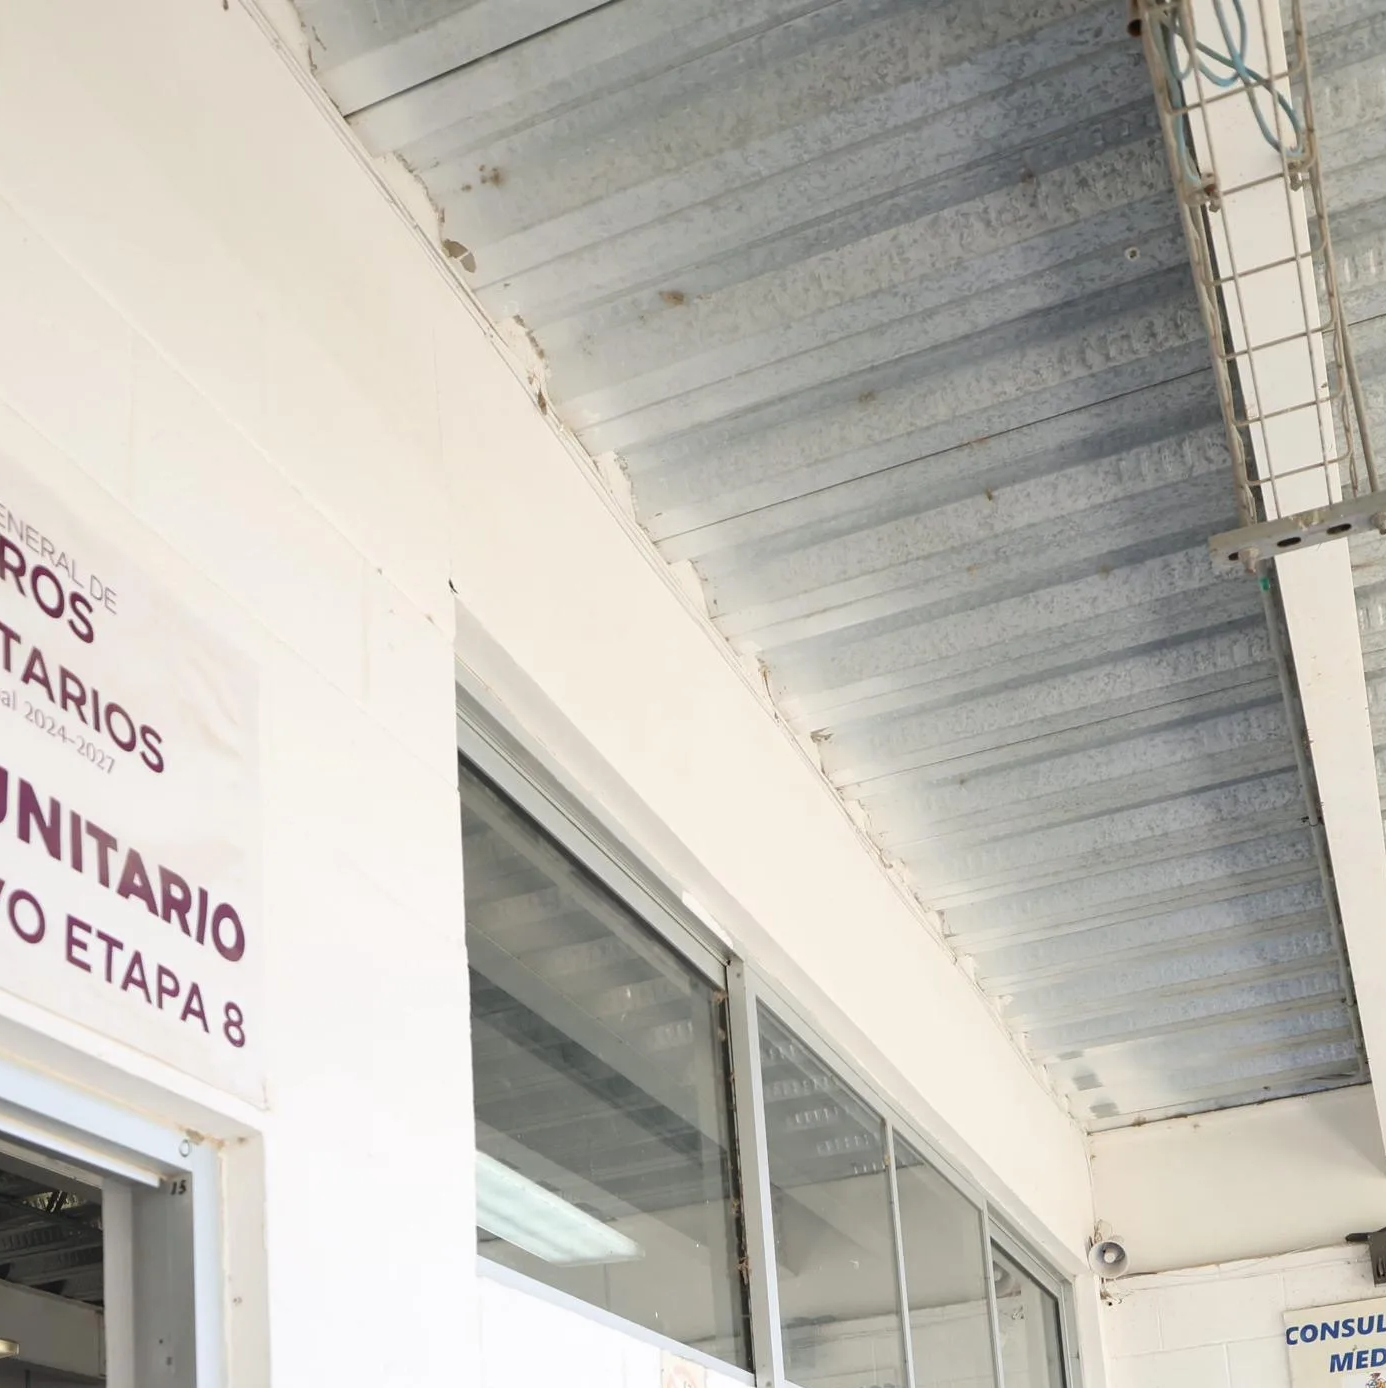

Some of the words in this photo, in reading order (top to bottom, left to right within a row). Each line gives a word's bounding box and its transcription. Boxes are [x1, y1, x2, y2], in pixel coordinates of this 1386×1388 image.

[89, 574, 118, 615] DE
[23, 700, 116, 775] 2024-2027
[64, 920, 210, 1034] ETAPA
[221, 999, 247, 1048] 8
